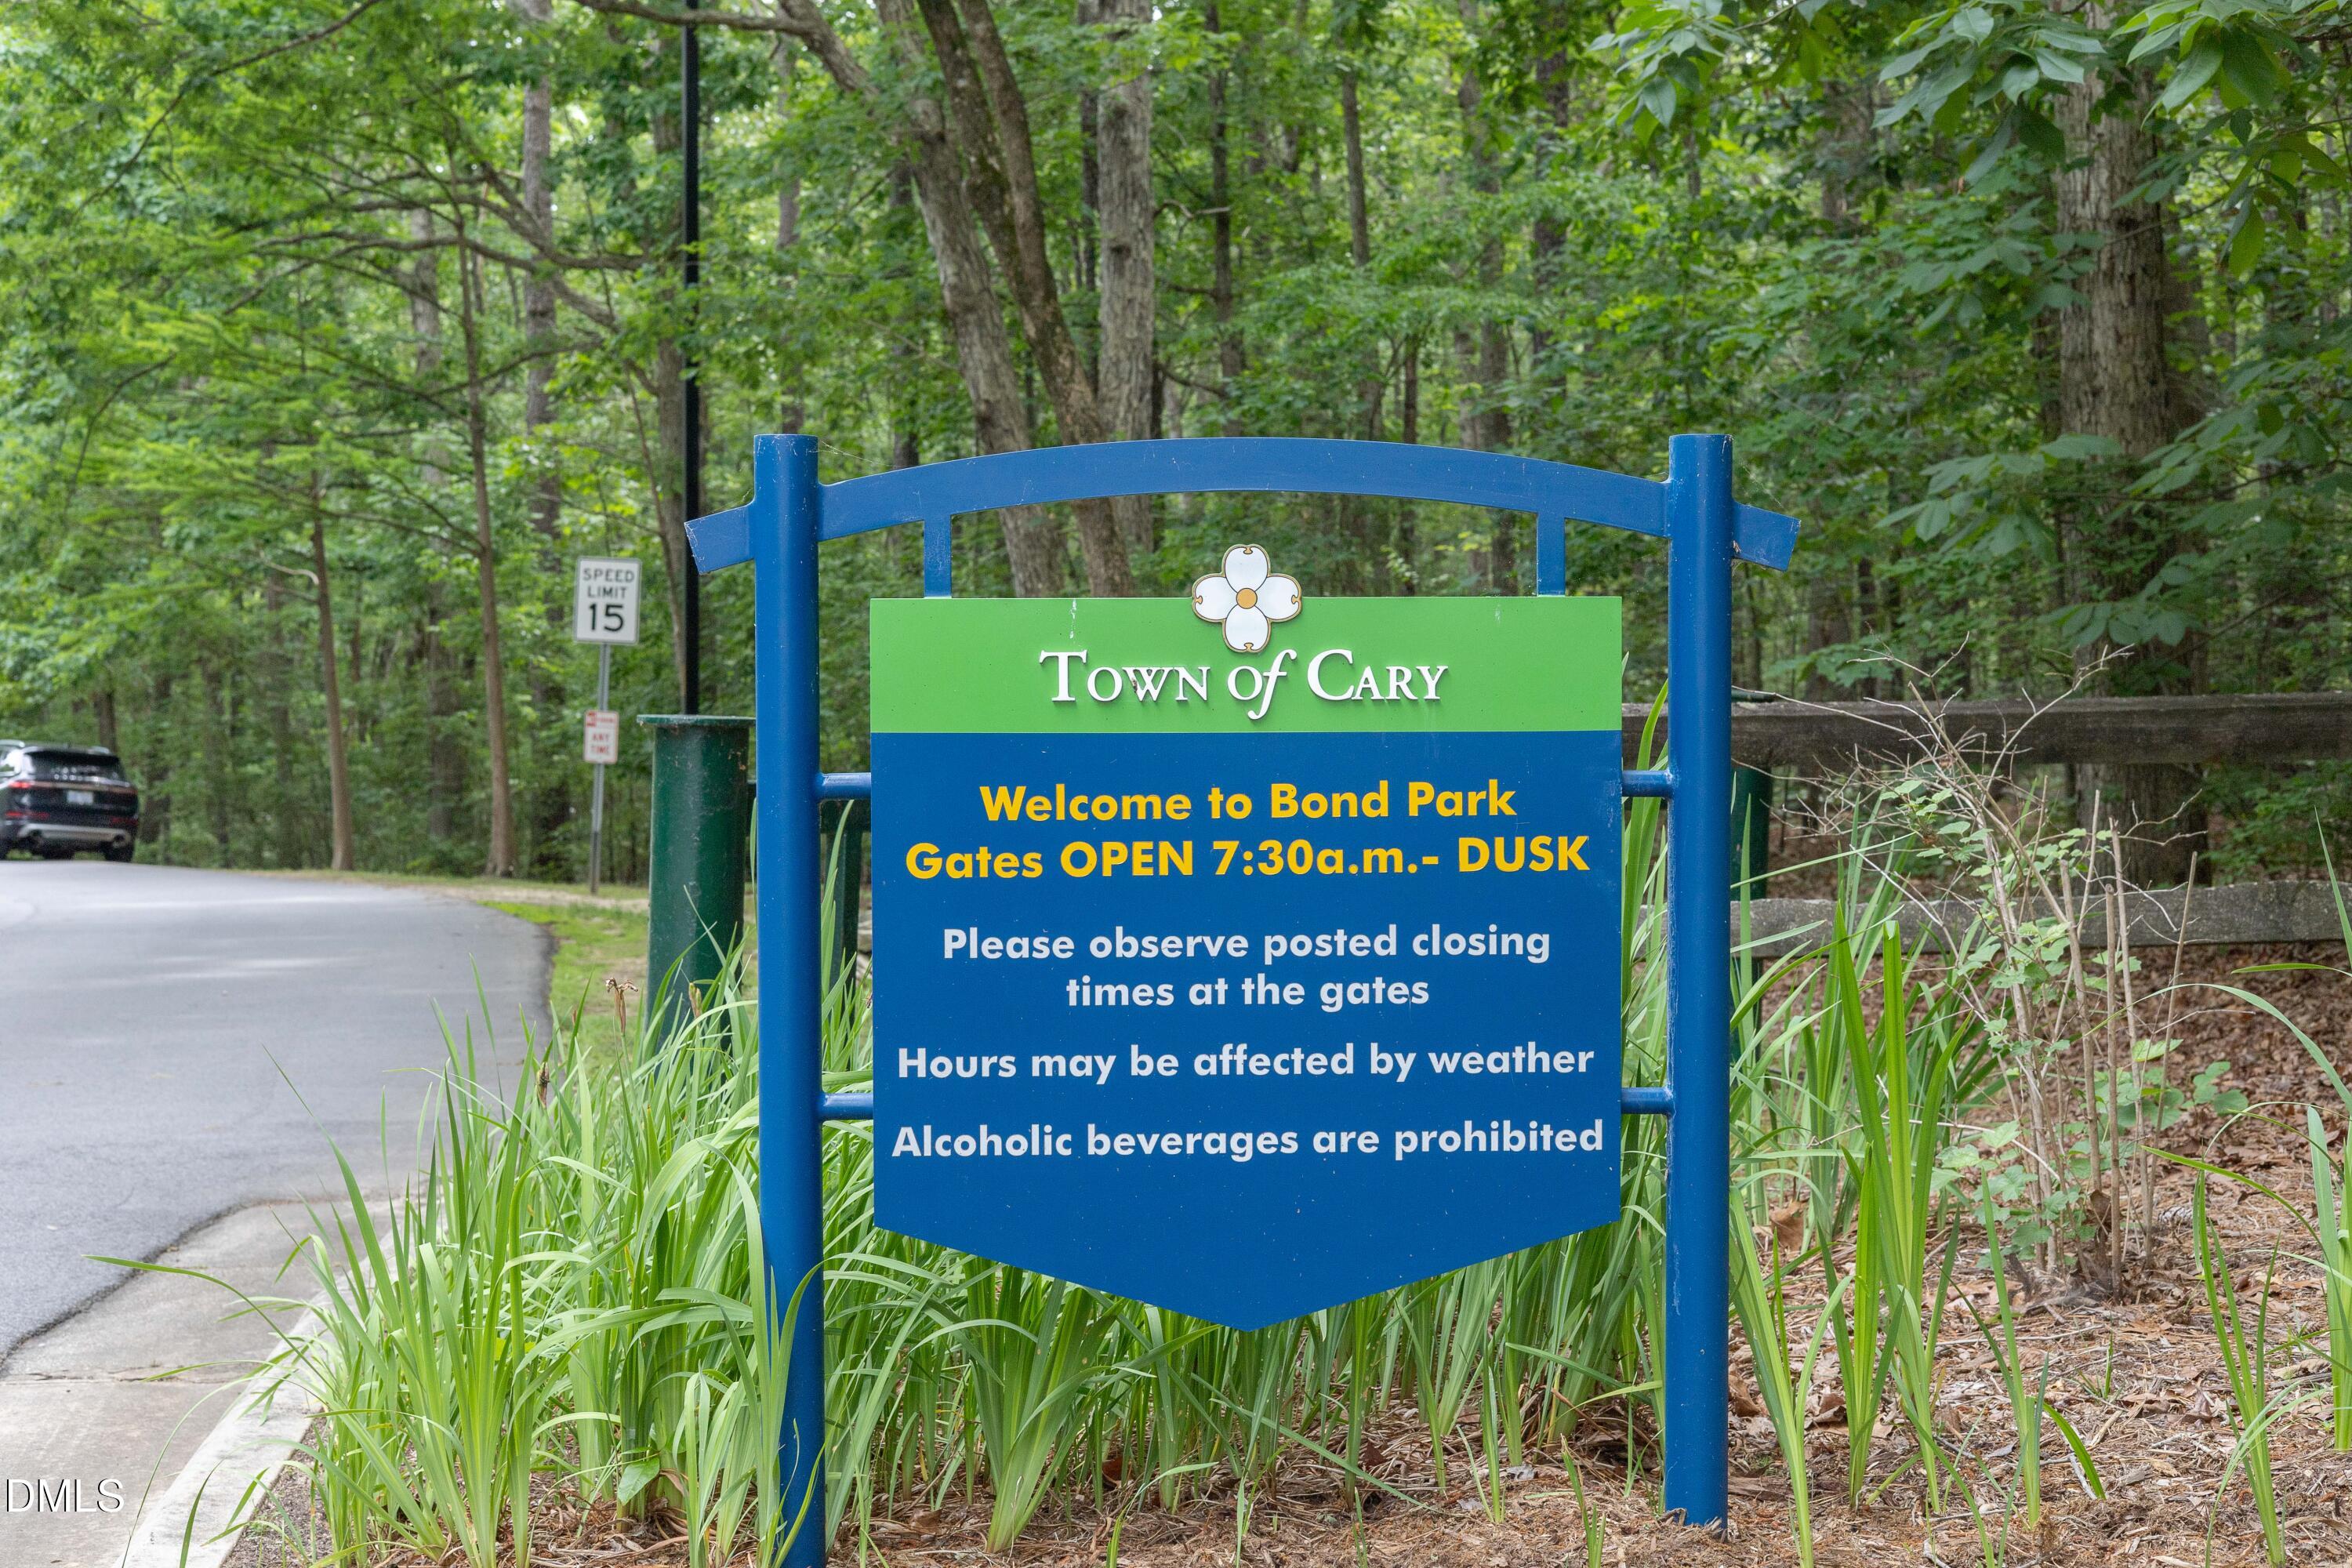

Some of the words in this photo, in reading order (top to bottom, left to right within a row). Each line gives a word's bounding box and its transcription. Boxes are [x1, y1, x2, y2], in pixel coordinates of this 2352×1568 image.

[583, 568, 635, 583] SPEED
[587, 586, 628, 599] LIMIT
[589, 603, 624, 632] 15
[1227, 649, 1297, 720] of
[980, 784, 1192, 822] Welcome
[1208, 787, 1252, 819] to
[1271, 780, 1388, 818] Bond
[1408, 779, 1516, 817] Park
[906, 842, 1043, 879] Gates
[1060, 840, 1193, 877] OPEN
[1458, 835, 1590, 873] DUSK
[944, 927, 1075, 960] Please
[1089, 926, 1249, 959] observe
[1264, 924, 1397, 965] posted
[1412, 924, 1550, 964] closing
[1065, 975, 1174, 1007] times
[1189, 978, 1229, 1006] at
[1241, 972, 1305, 1005] the
[1319, 976, 1429, 1013] gates
[898, 1047, 1017, 1079] Hours
[1032, 1054, 1116, 1085] may
[1131, 1044, 1179, 1076] be
[1193, 1042, 1354, 1076] affected
[1370, 1042, 1417, 1083] by
[1428, 1041, 1595, 1074] weather
[891, 1123, 1072, 1157] Alcoholic
[1087, 1123, 1298, 1163] beverages
[1312, 1131, 1380, 1154] are
[1395, 1119, 1603, 1161] prohibited
